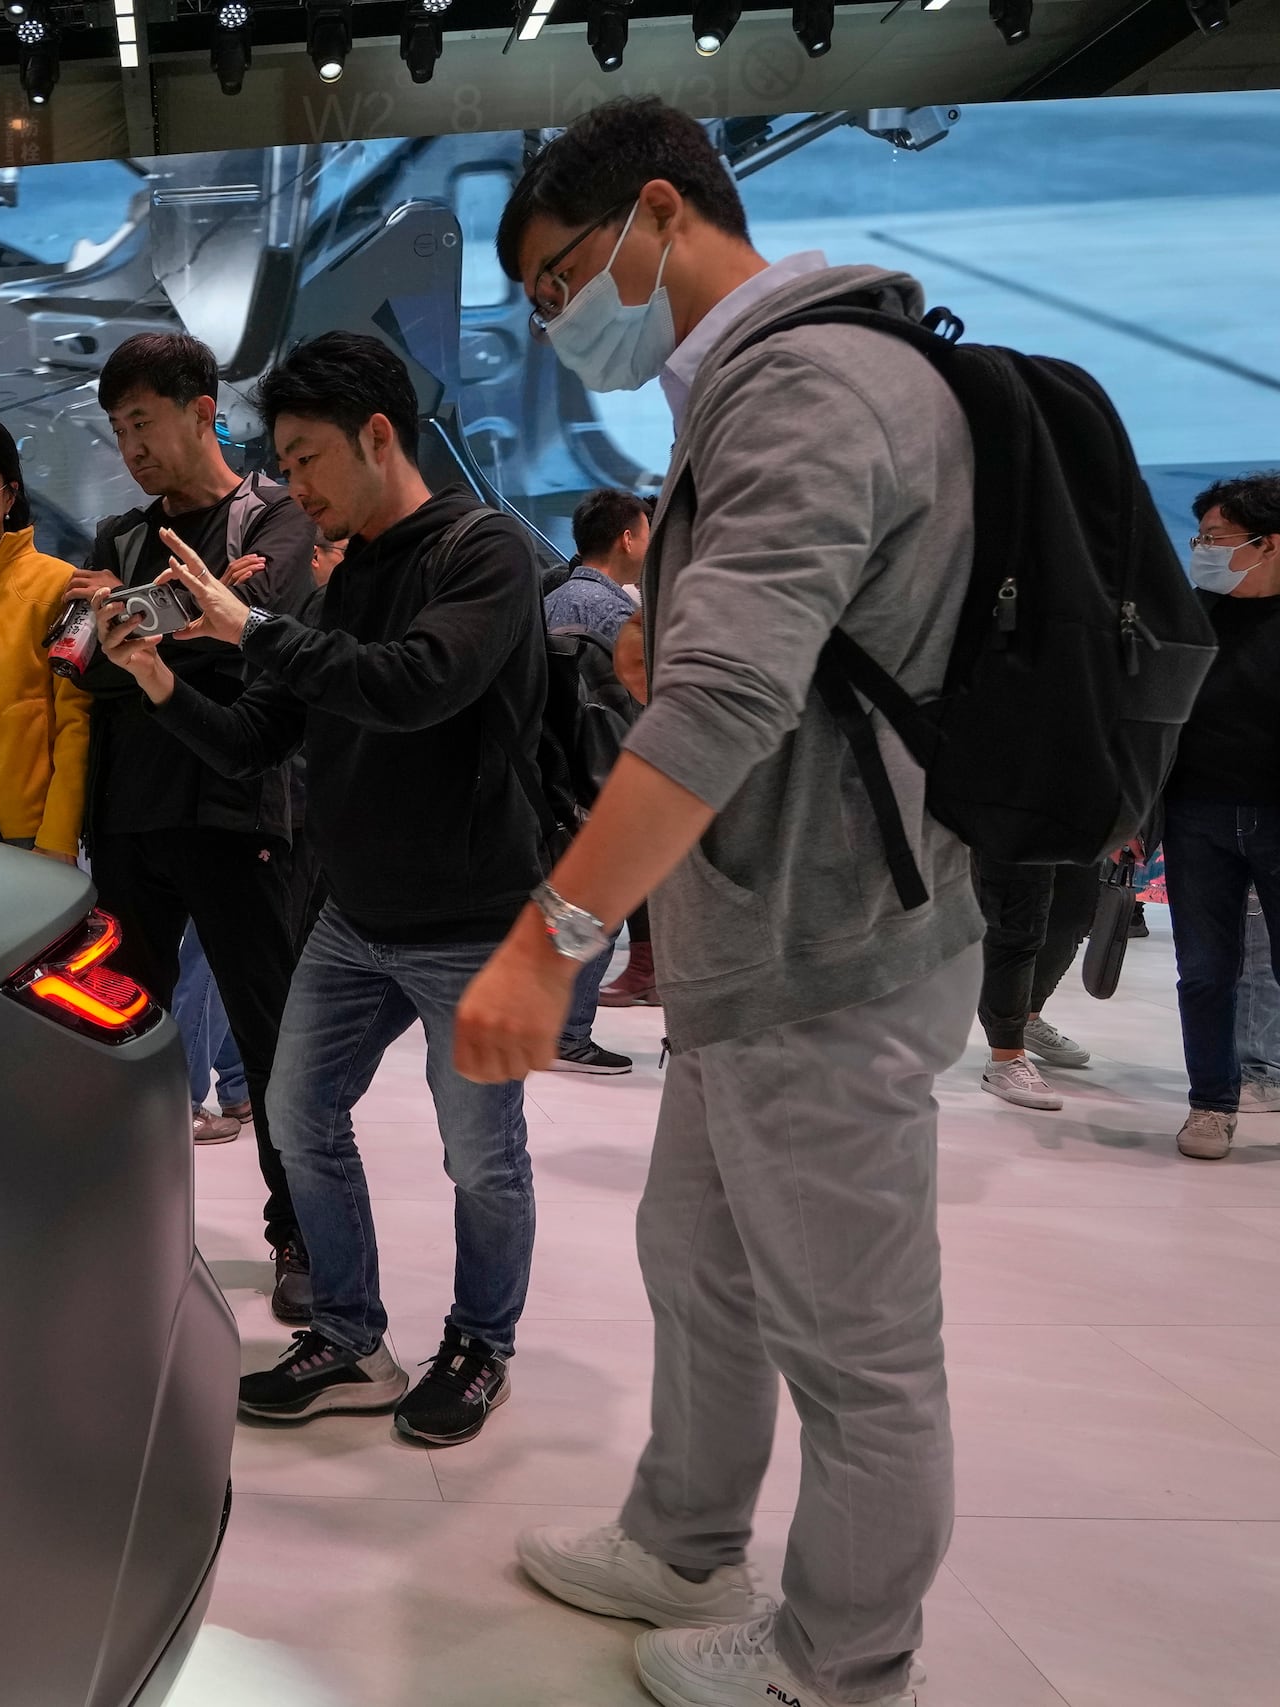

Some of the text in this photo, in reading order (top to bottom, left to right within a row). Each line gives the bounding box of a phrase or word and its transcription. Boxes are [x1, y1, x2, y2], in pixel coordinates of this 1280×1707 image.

[302, 83, 483, 143] W2 8
[766, 1683, 802, 1707] FILA
